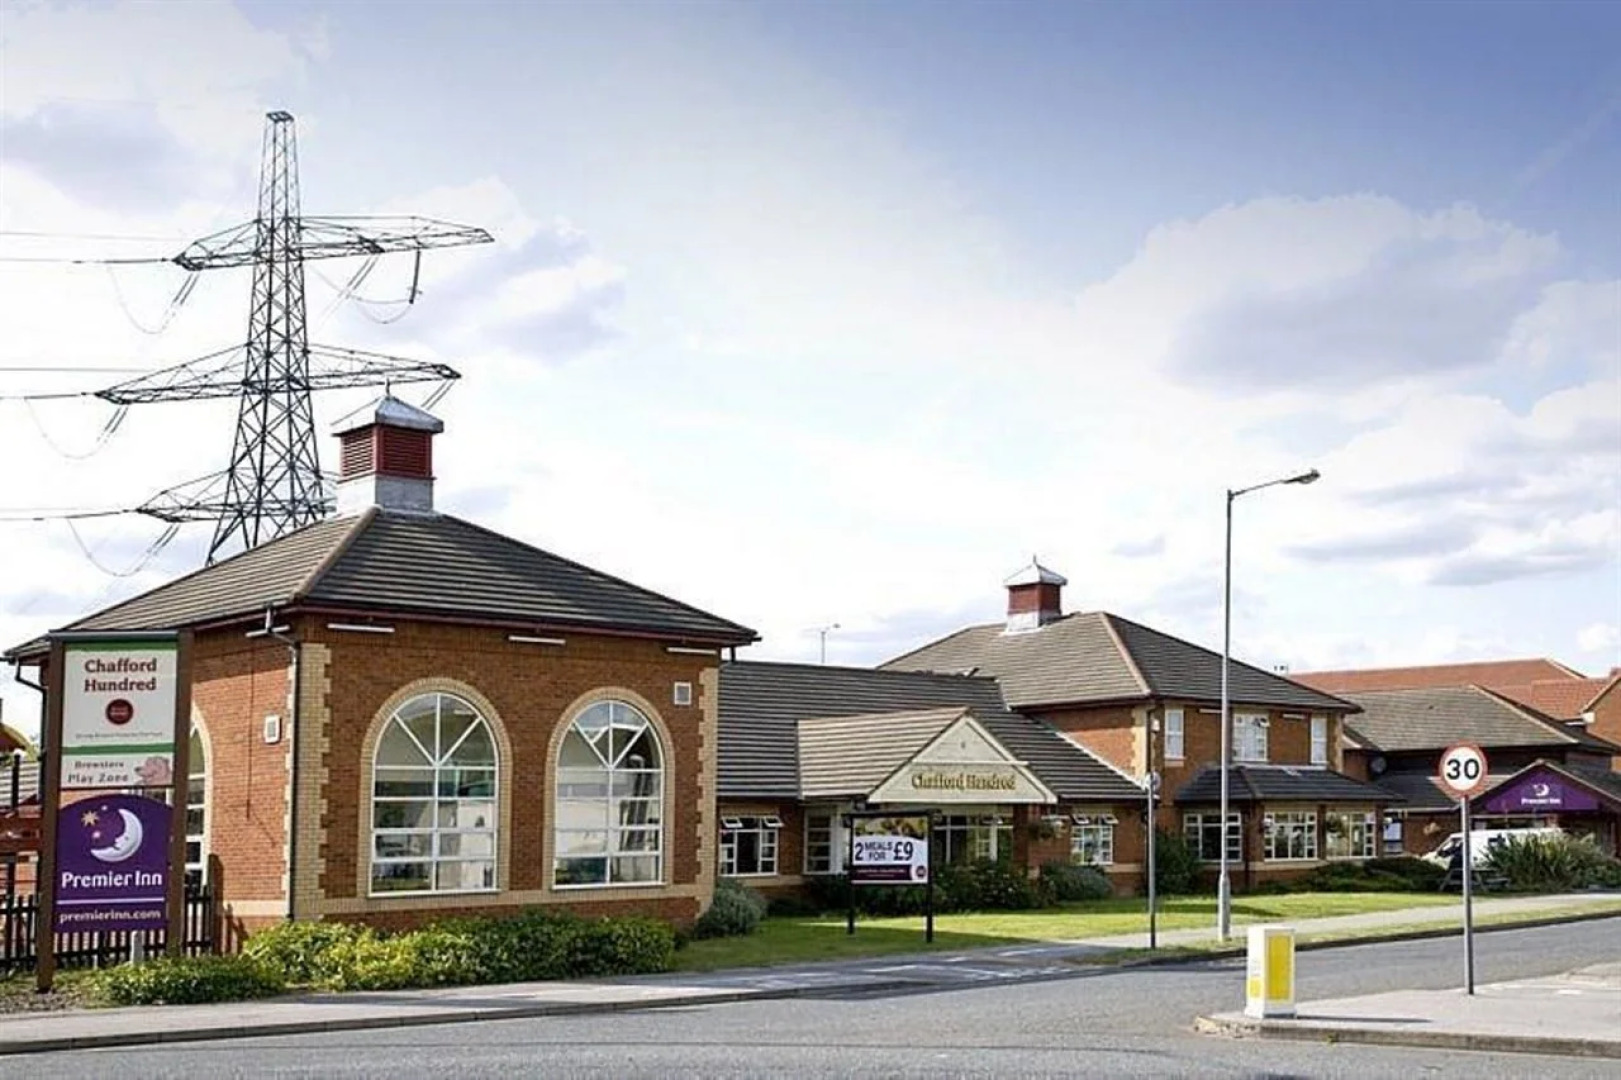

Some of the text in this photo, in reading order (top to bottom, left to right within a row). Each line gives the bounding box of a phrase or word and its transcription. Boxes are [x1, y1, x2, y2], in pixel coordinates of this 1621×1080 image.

[84, 658, 157, 673] Chafford
[84, 677, 157, 692] Hundred
[1446, 758, 1480, 780] 30
[67, 773, 129, 784] Play Zone
[854, 841, 914, 861] 2 MEALS FOR £9
[61, 870, 163, 888] Premier Inn
[59, 909, 161, 924] premierinn.com
